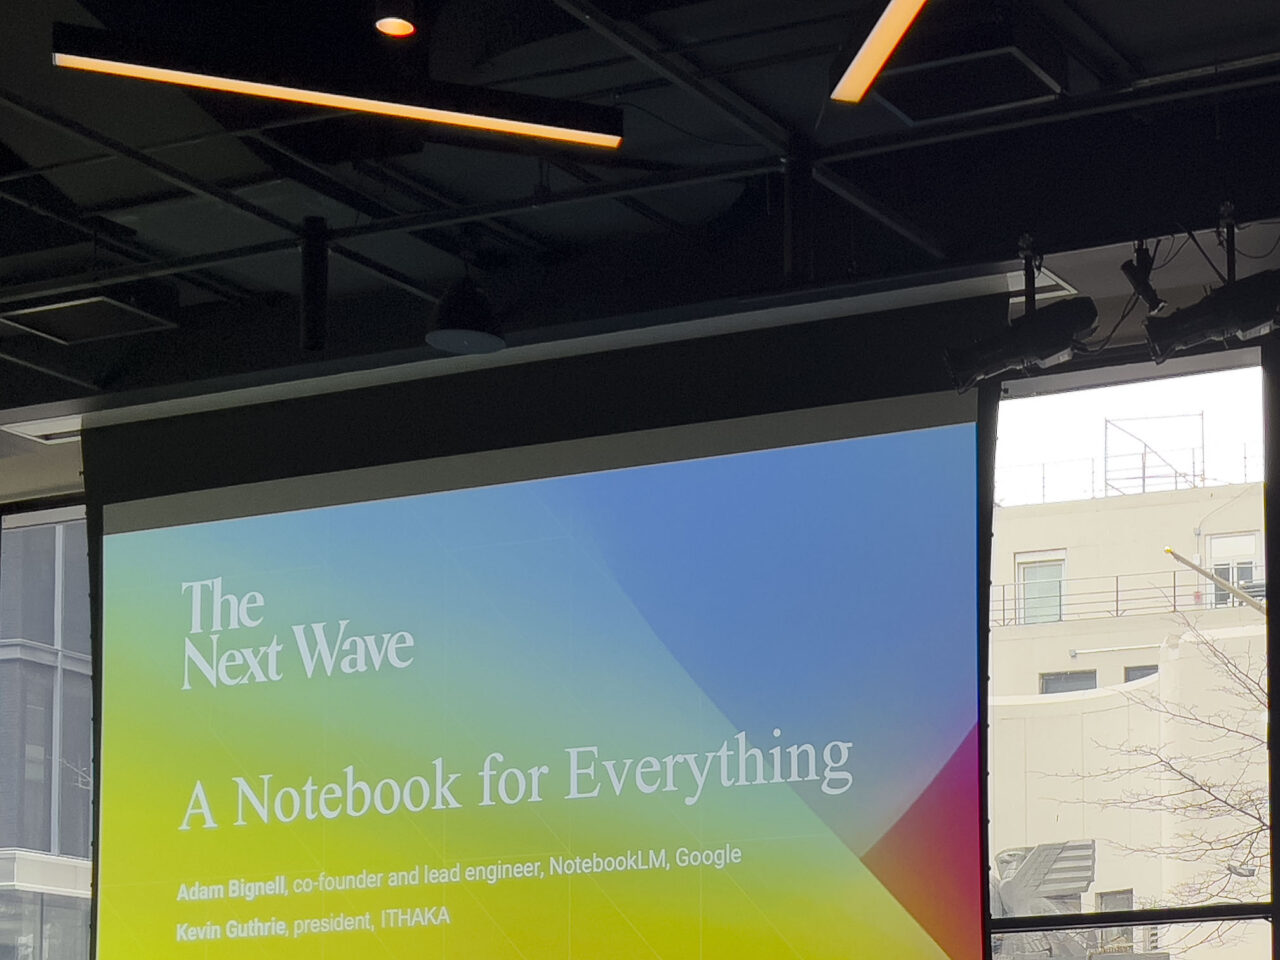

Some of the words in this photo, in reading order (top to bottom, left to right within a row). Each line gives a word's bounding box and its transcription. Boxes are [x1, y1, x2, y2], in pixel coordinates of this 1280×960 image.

[181, 576, 265, 634] The
[181, 634, 284, 690] Next
[291, 619, 415, 679] Wave
[178, 779, 218, 831] A
[231, 756, 463, 826] Notebook
[478, 752, 550, 807] for
[564, 728, 854, 806] Everything
[176, 882, 224, 901] Adam
[228, 874, 289, 901] Bignell,
[292, 869, 384, 894] co-founder
[387, 865, 420, 887] and
[424, 862, 461, 884] lead
[464, 859, 546, 885] engineer,
[549, 848, 671, 877] NotebookLM,
[675, 843, 742, 871] Google
[176, 921, 221, 942] Kevin
[225, 916, 289, 939] Guthrie,
[293, 910, 375, 938] president,
[380, 905, 451, 929] ITHAKA
